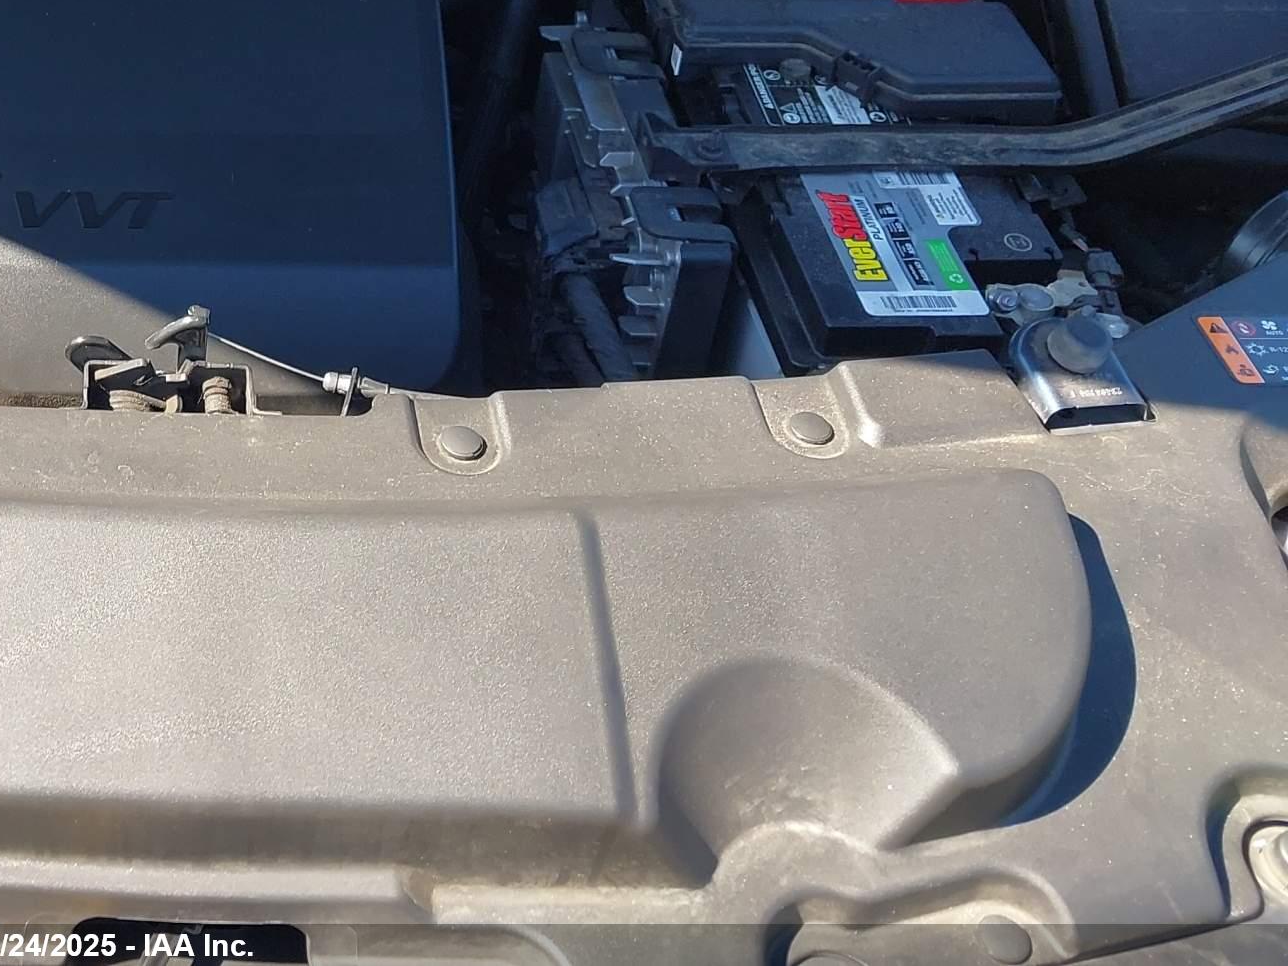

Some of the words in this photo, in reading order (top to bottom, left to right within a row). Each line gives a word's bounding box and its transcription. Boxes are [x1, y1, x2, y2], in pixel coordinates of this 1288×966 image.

[14, 191, 174, 228] VVT
[854, 198, 884, 240] PLATINUM
[816, 191, 889, 281] EverStart
